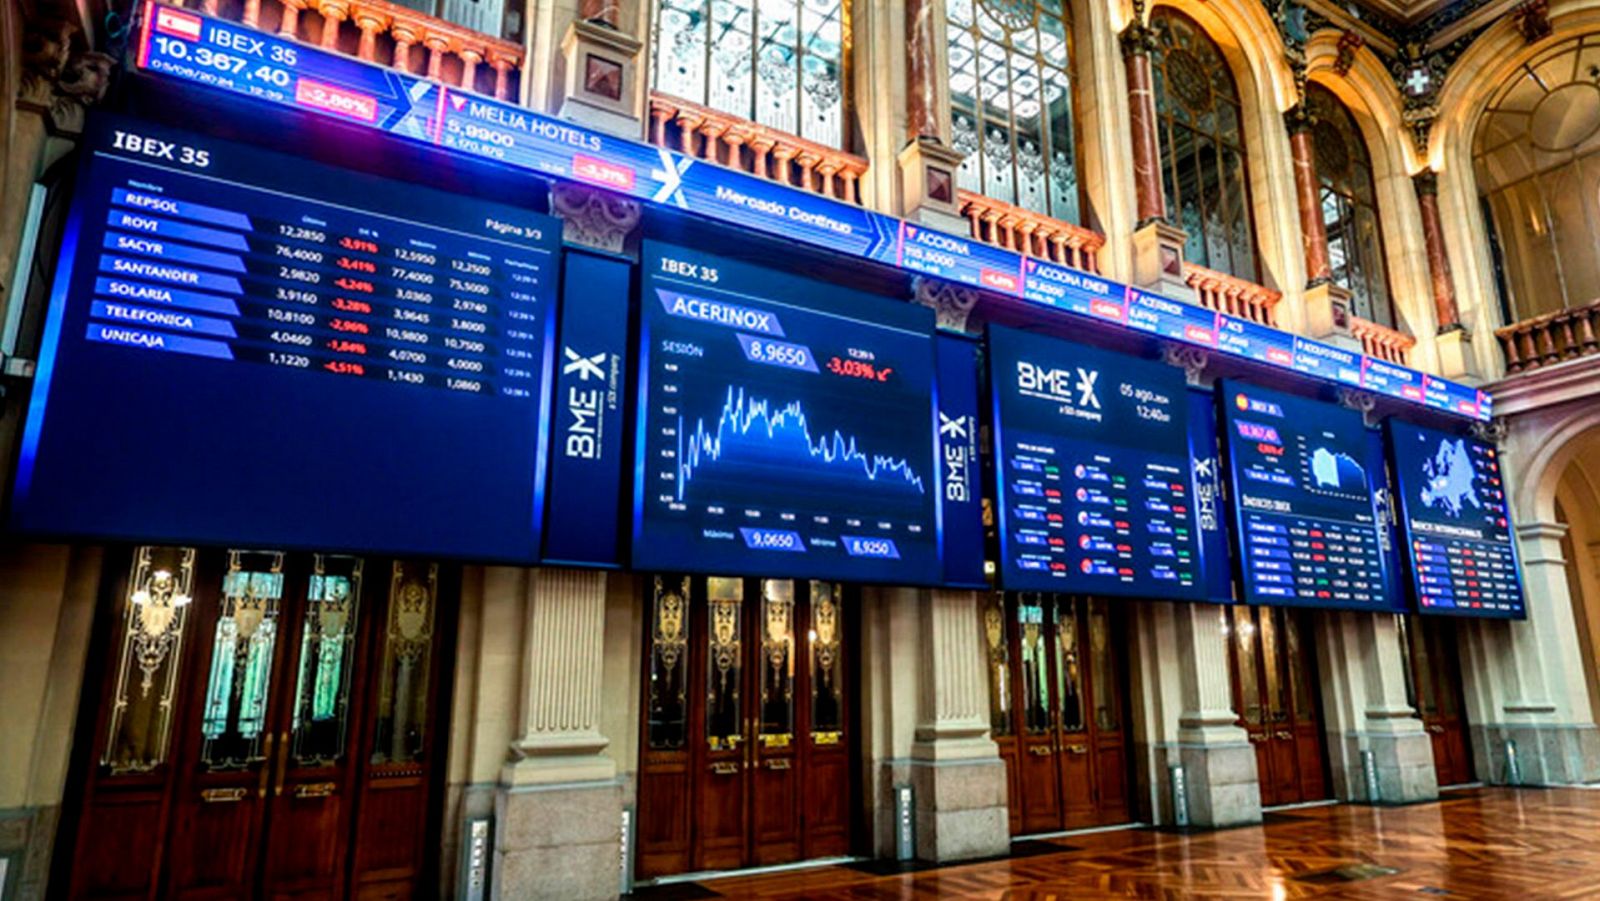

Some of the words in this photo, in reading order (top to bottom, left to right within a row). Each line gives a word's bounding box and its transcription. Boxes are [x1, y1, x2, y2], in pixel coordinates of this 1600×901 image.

[155, 36, 290, 86] 10.367,40
[208, 27, 266, 57] IBEX
[270, 45, 297, 66] 35
[447, 119, 515, 148] 5,9900
[470, 103, 529, 130] MELIA
[531, 116, 602, 152] HOTELS
[112, 130, 176, 161] IBEX
[179, 146, 210, 168] 35
[715, 185, 787, 216] Mercado
[125, 193, 180, 214] REPSOL
[280, 224, 326, 243] 12,2850
[339, 236, 379, 254] -3,91%
[452, 259, 492, 277] 12,2500
[485, 218, 523, 236] Página
[524, 226, 543, 241] 3/3
[917, 231, 970, 256] ACCIONA
[121, 215, 158, 232] ROVI
[276, 244, 323, 263] 76,4000
[336, 256, 376, 273] -3,41%
[391, 267, 434, 285] 77,4000
[450, 278, 490, 296] 75,5000
[660, 257, 698, 279] IBEX
[700, 265, 719, 283] 35
[118, 236, 163, 254] SACYR
[279, 266, 320, 284] 2,9820
[453, 298, 488, 315] 2,9740
[114, 259, 199, 285] SANTANDER
[276, 287, 318, 305] 3,9160
[394, 308, 431, 324] 3,9645
[451, 318, 486, 334] 3,8000
[672, 297, 771, 332] ACERINOX
[109, 282, 173, 302] SOLARIA
[268, 308, 316, 326] 10,8100
[385, 327, 429, 345] 10,9800
[444, 337, 485, 353] 10,7500
[105, 304, 193, 329] TELEFONICA
[270, 331, 313, 347] 4,0460
[388, 349, 427, 364] 4,0700
[447, 357, 483, 373] 4,0000
[662, 339, 704, 358] SESIÓN
[750, 340, 807, 366] 8,9650
[101, 327, 165, 348] UNICAJA
[269, 352, 310, 368] 1,1220
[323, 361, 365, 377] -4,51%
[387, 369, 425, 384] 1,1430
[446, 378, 481, 393] 1,0860
[825, 357, 875, 379] -3,03%
[1018, 360, 1072, 397] BME
[1120, 382, 1134, 398] 05
[566, 386, 598, 459] BME
[944, 444, 966, 502] BME
[1198, 482, 1213, 531] BME
[752, 532, 794, 549] 9,0650
[853, 541, 889, 555] 8,9250
